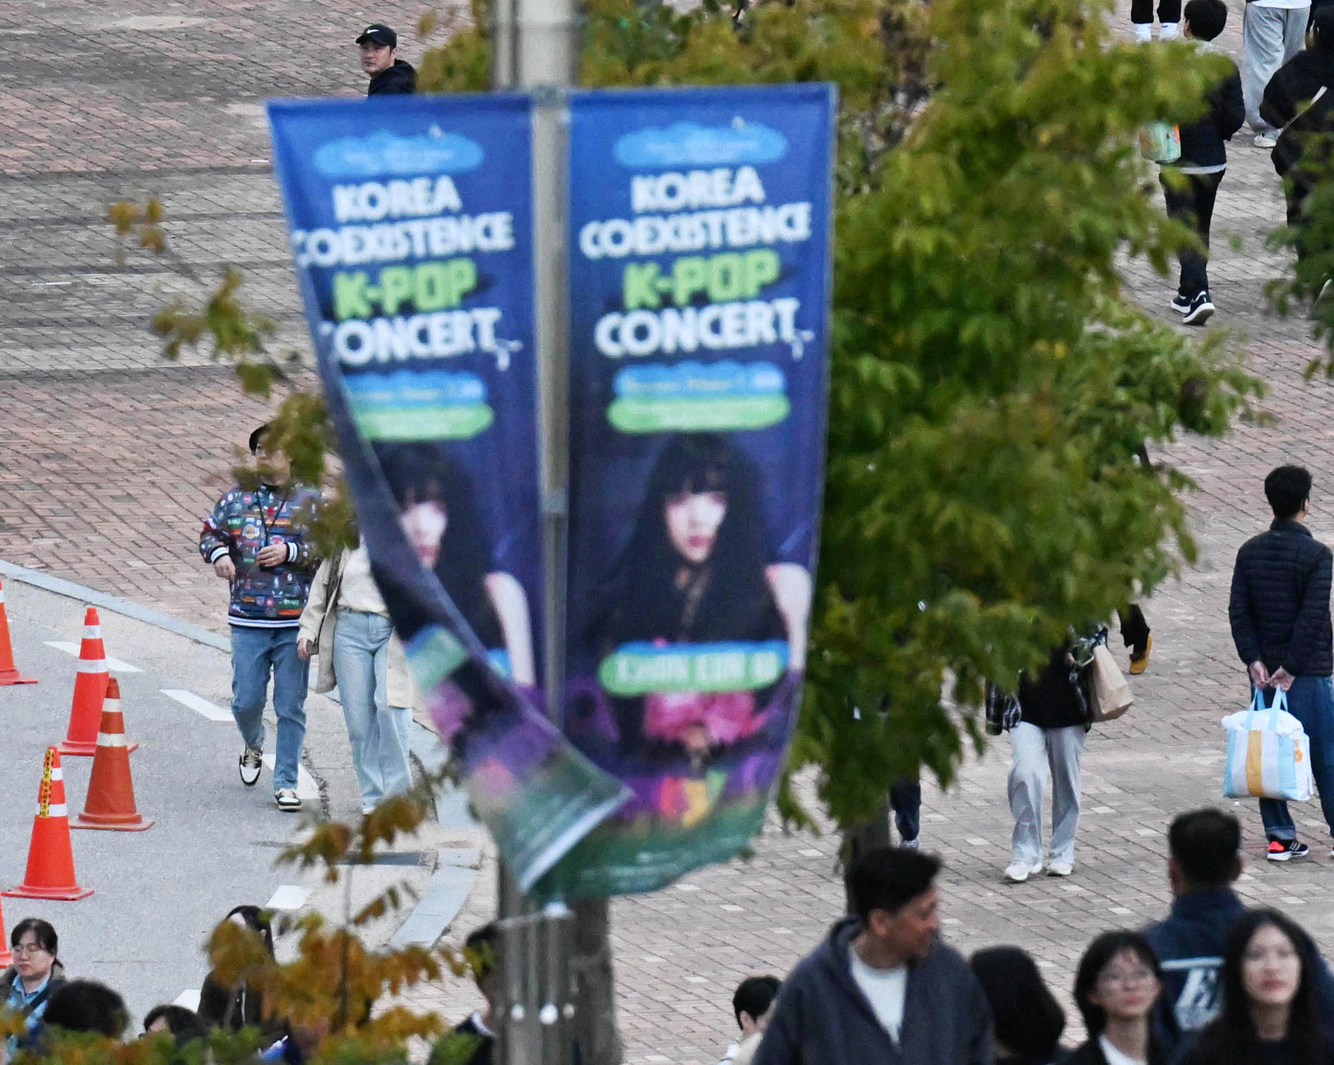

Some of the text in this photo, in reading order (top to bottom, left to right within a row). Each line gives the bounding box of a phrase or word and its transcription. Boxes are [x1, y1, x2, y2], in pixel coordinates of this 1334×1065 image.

[331, 175, 463, 223] KOREA
[630, 165, 765, 213] KOREA
[579, 201, 813, 260] COEXISTENCE
[331, 257, 479, 321] K-POP
[621, 248, 781, 310] K-POP
[322, 306, 507, 366] ONCERT
[594, 297, 802, 358] CONCERT
